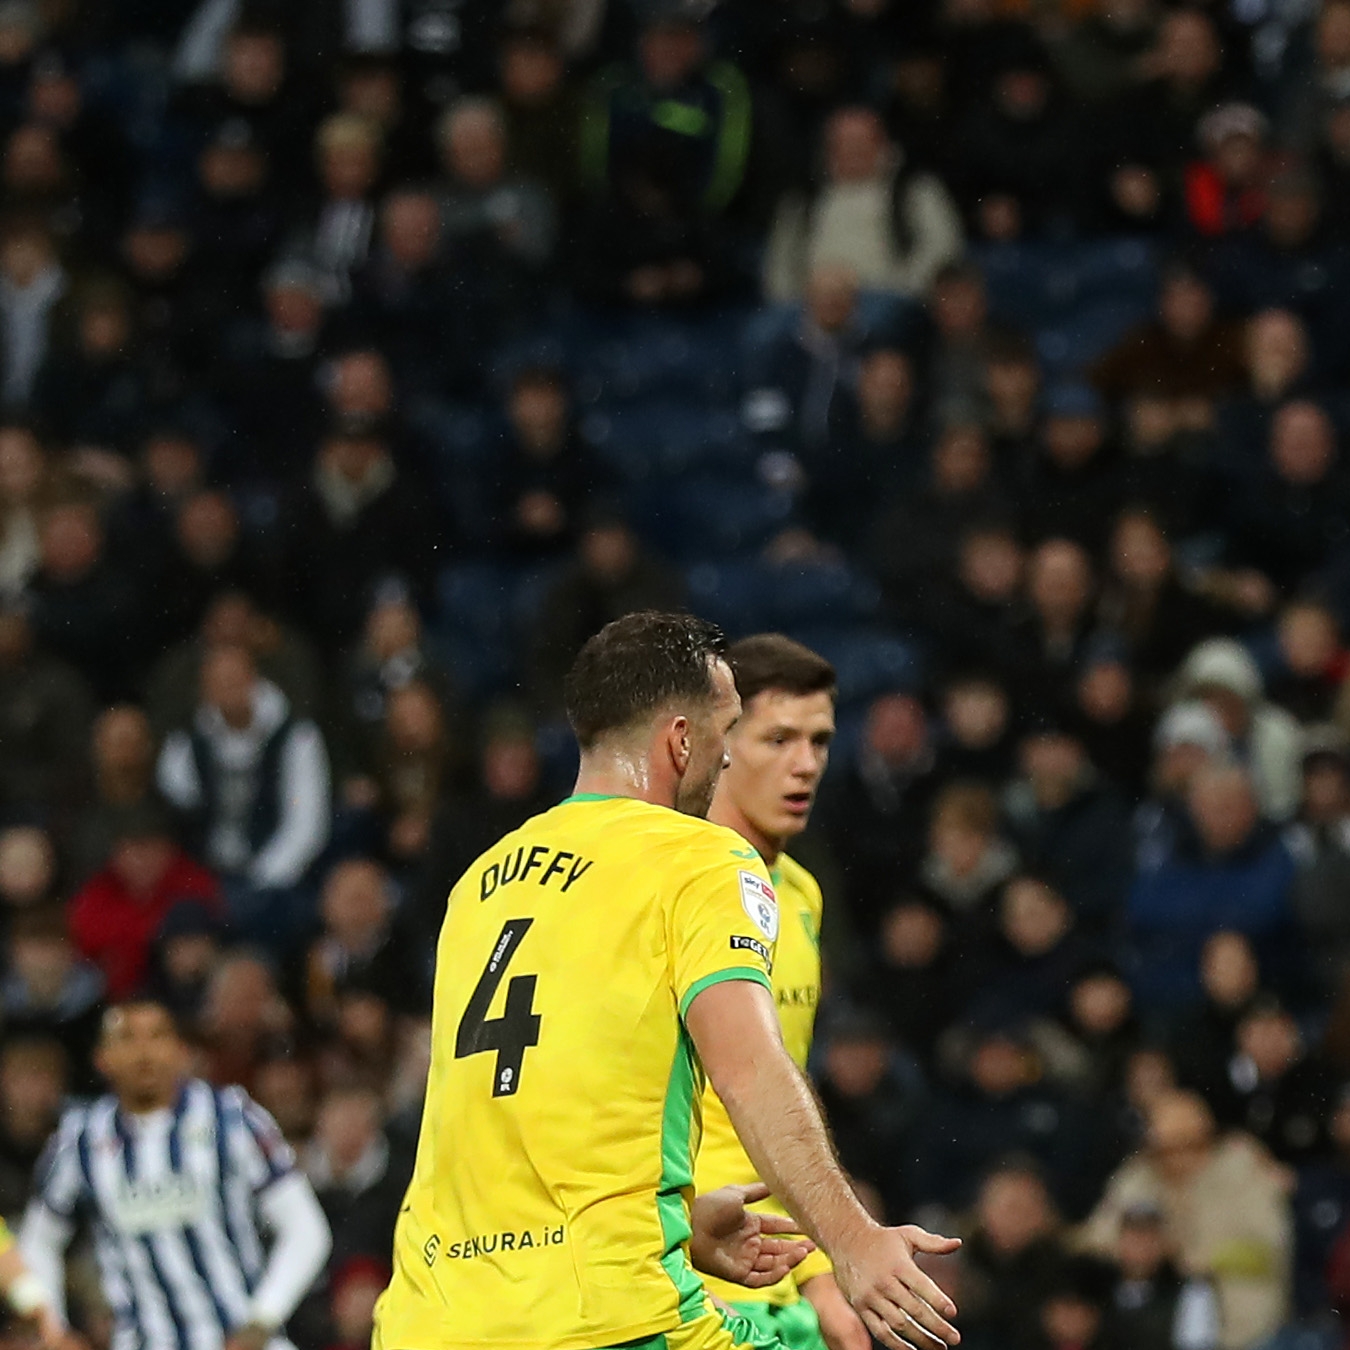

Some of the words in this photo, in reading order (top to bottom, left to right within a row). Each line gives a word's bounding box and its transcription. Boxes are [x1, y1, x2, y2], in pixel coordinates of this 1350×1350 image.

[480, 846, 594, 902] DUFFY
[455, 917, 542, 1098] 4
[446, 1225, 564, 1259] SEKURA.id
